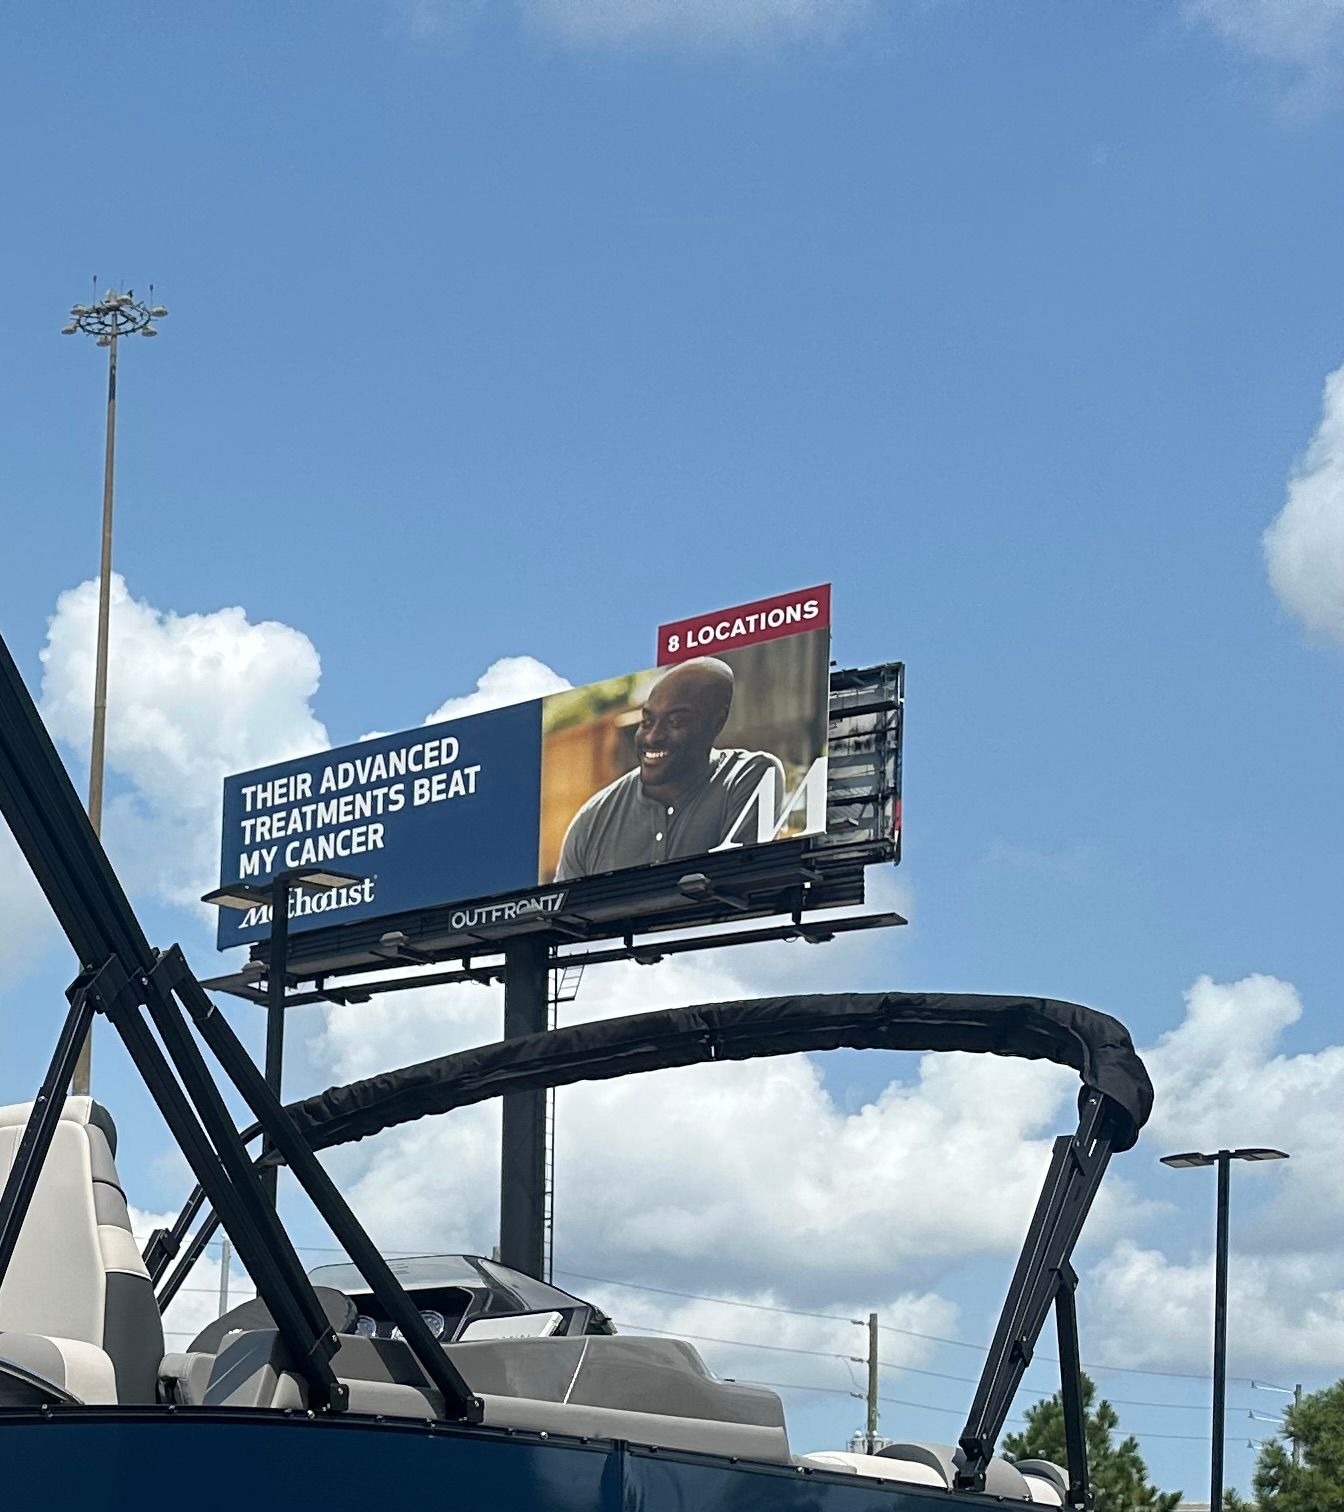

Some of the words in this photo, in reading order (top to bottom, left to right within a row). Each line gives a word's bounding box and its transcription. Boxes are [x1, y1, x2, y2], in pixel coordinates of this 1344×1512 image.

[667, 634, 680, 653] 8
[686, 599, 819, 649] LOCATIONS
[240, 783, 405, 845] TREATMENTS
[412, 765, 482, 807] BEAT
[241, 772, 313, 812] THEIR
[319, 736, 460, 794] ADVANCED
[239, 845, 279, 879] MY
[285, 822, 385, 868] CANCER
